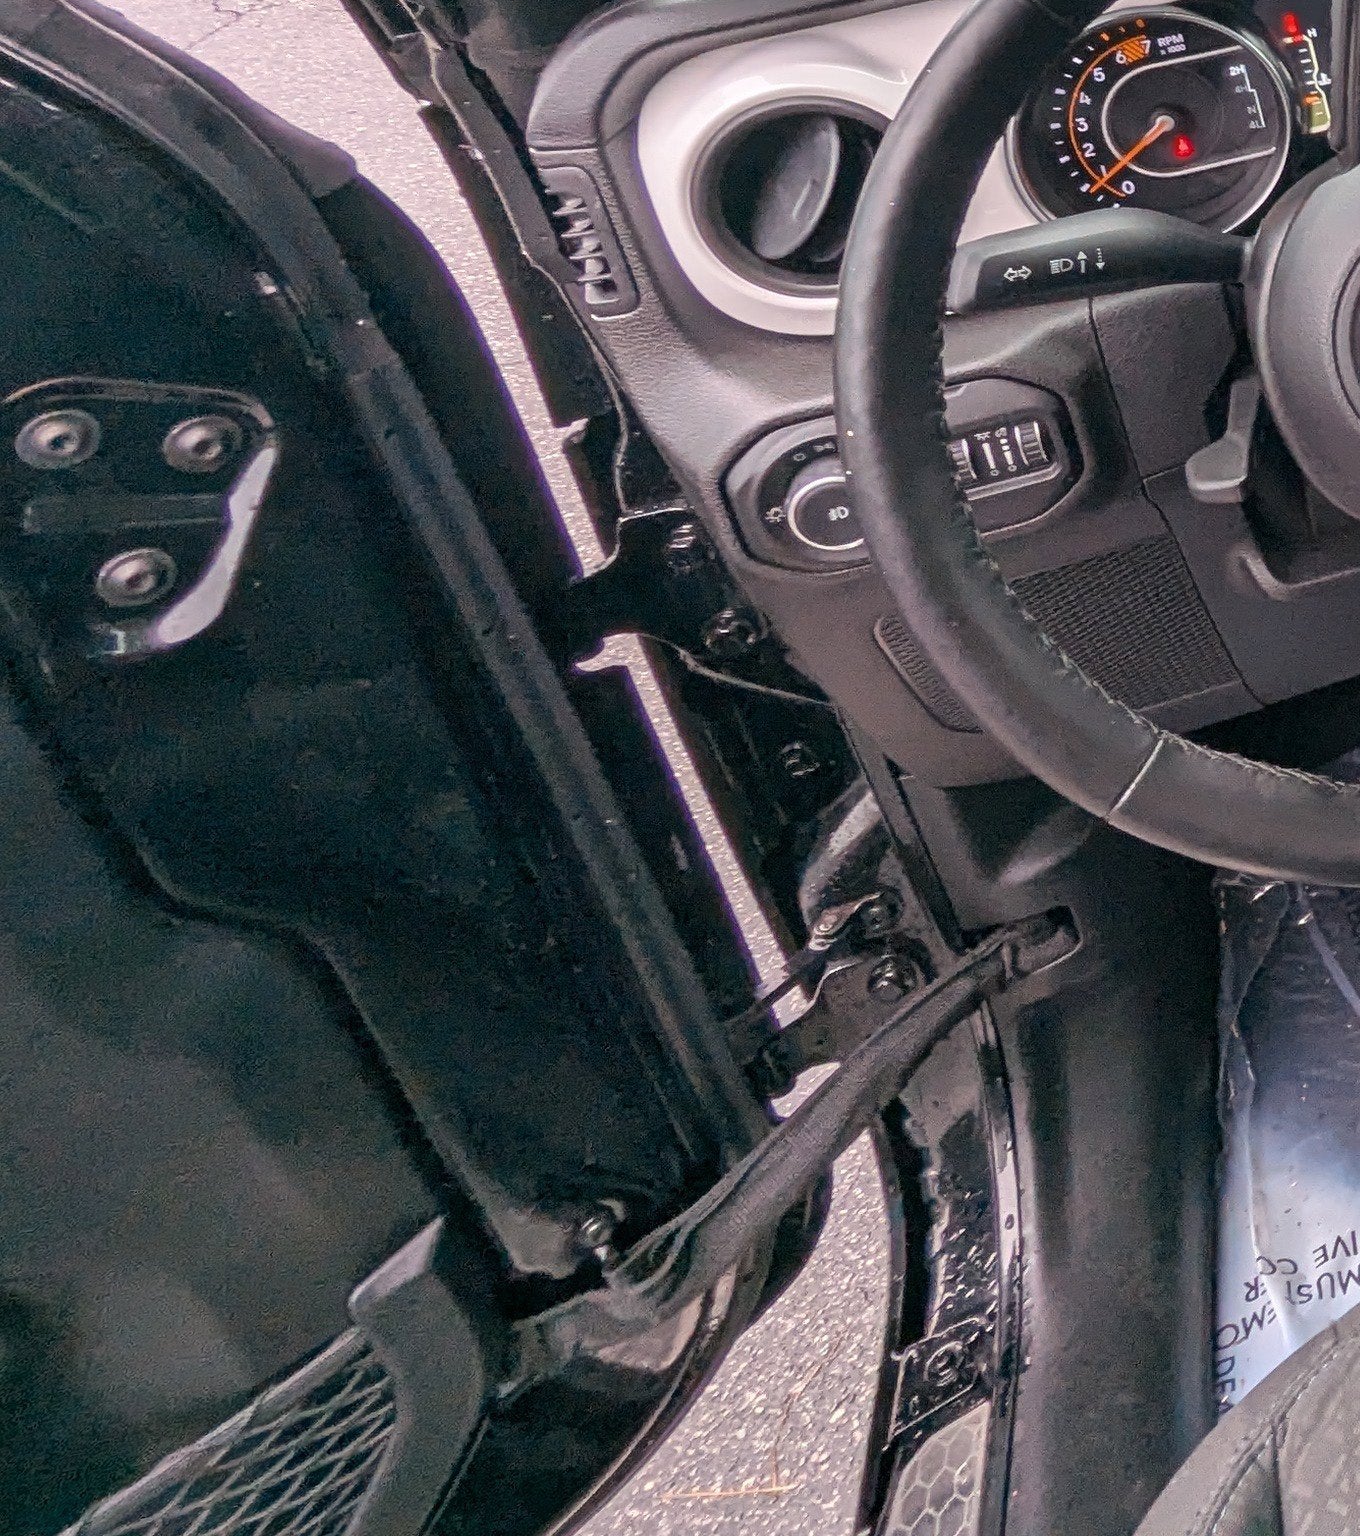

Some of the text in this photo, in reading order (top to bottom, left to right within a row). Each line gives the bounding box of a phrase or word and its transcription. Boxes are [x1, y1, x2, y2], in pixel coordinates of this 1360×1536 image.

[1157, 33, 1185, 47] RPM
[1141, 40, 1151, 55] 7
[1167, 44, 1186, 53] 1000
[1115, 50, 1127, 64] 6
[1093, 67, 1105, 82] 5
[1079, 92, 1091, 105] 4
[1075, 117, 1089, 132] 3
[1082, 142, 1096, 157] 2
[1121, 180, 1135, 194] 0
